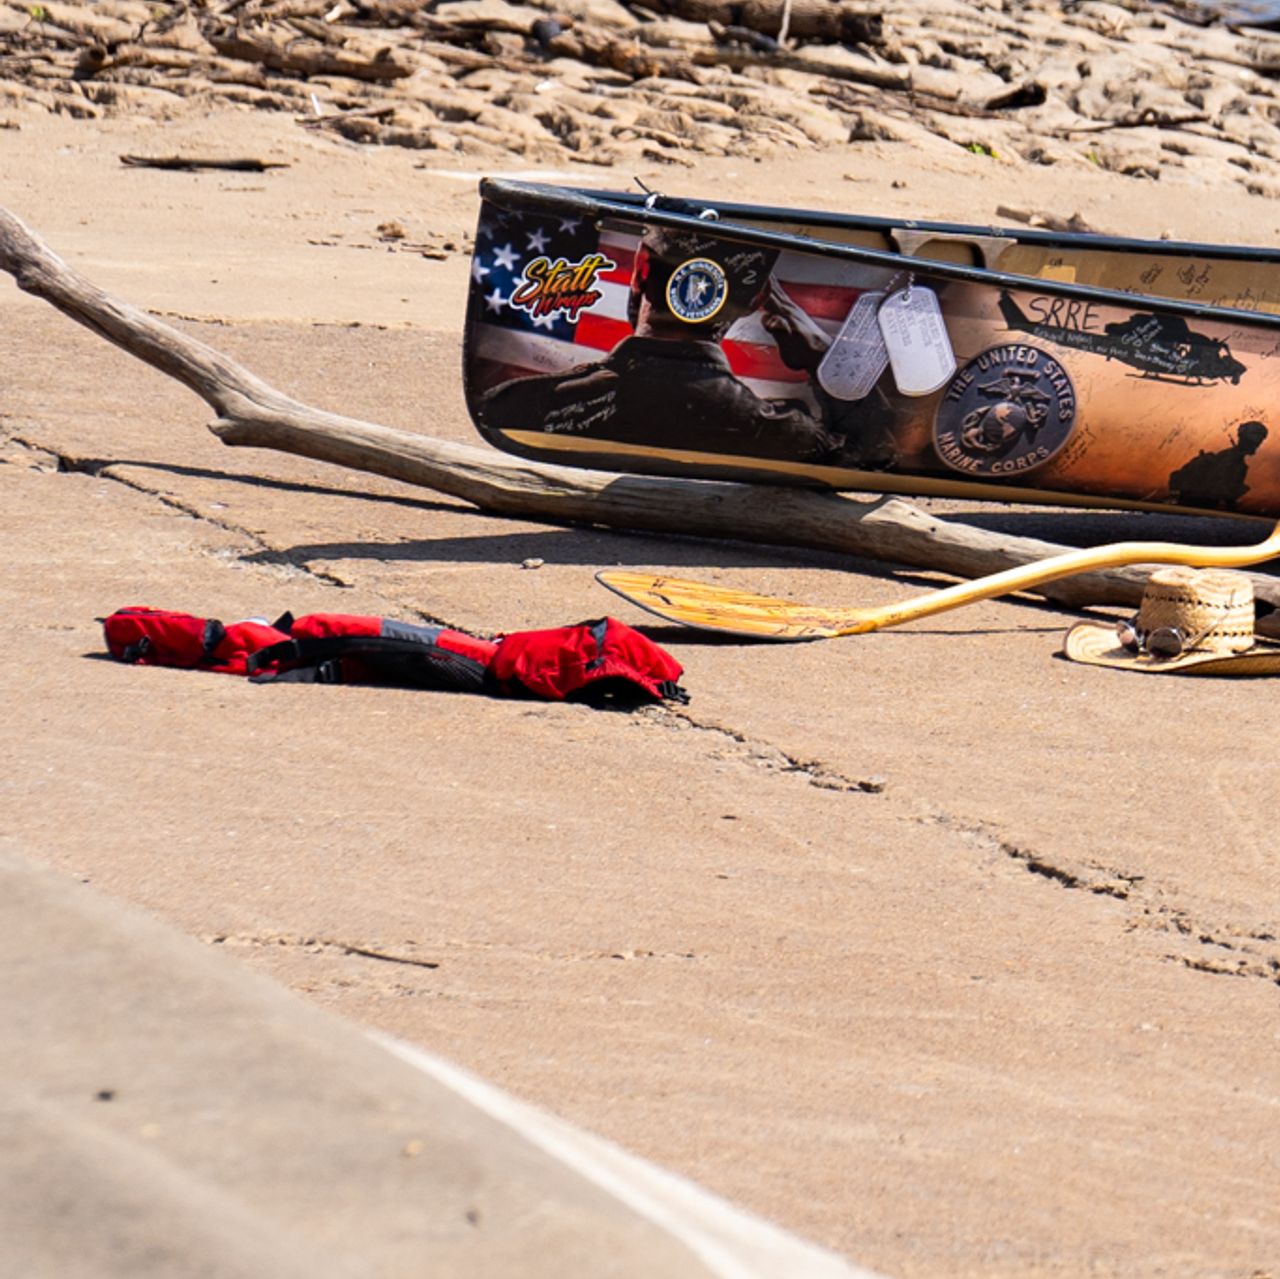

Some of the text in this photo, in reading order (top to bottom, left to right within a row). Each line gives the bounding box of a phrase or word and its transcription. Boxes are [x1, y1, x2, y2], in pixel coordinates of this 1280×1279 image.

[946, 345, 1074, 422] THE UNITED STATES
[937, 431, 984, 471] MARINE
[991, 445, 1050, 473] CORPS
